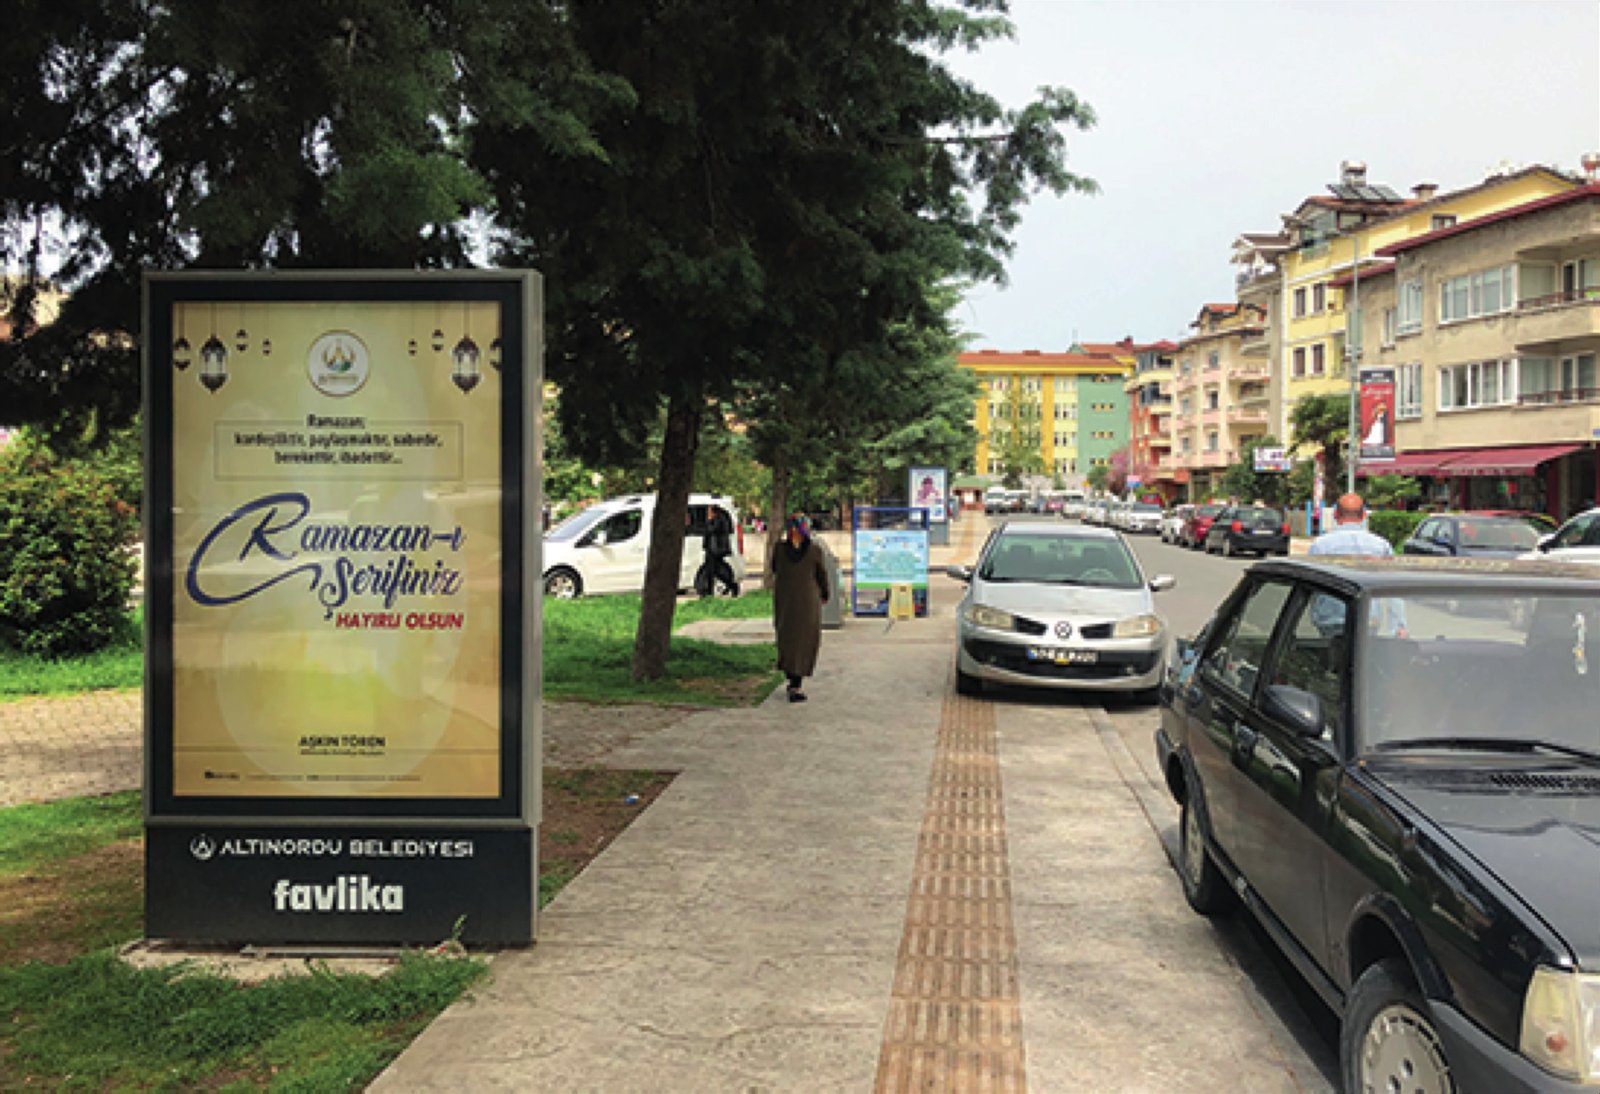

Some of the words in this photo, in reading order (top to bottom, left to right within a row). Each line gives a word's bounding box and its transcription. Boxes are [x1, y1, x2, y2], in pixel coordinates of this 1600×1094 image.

[335, 612, 401, 629] HAYIRLI
[404, 612, 465, 629] OLSUN
[219, 838, 343, 855] ALTINORDU
[273, 876, 404, 911] favlika
